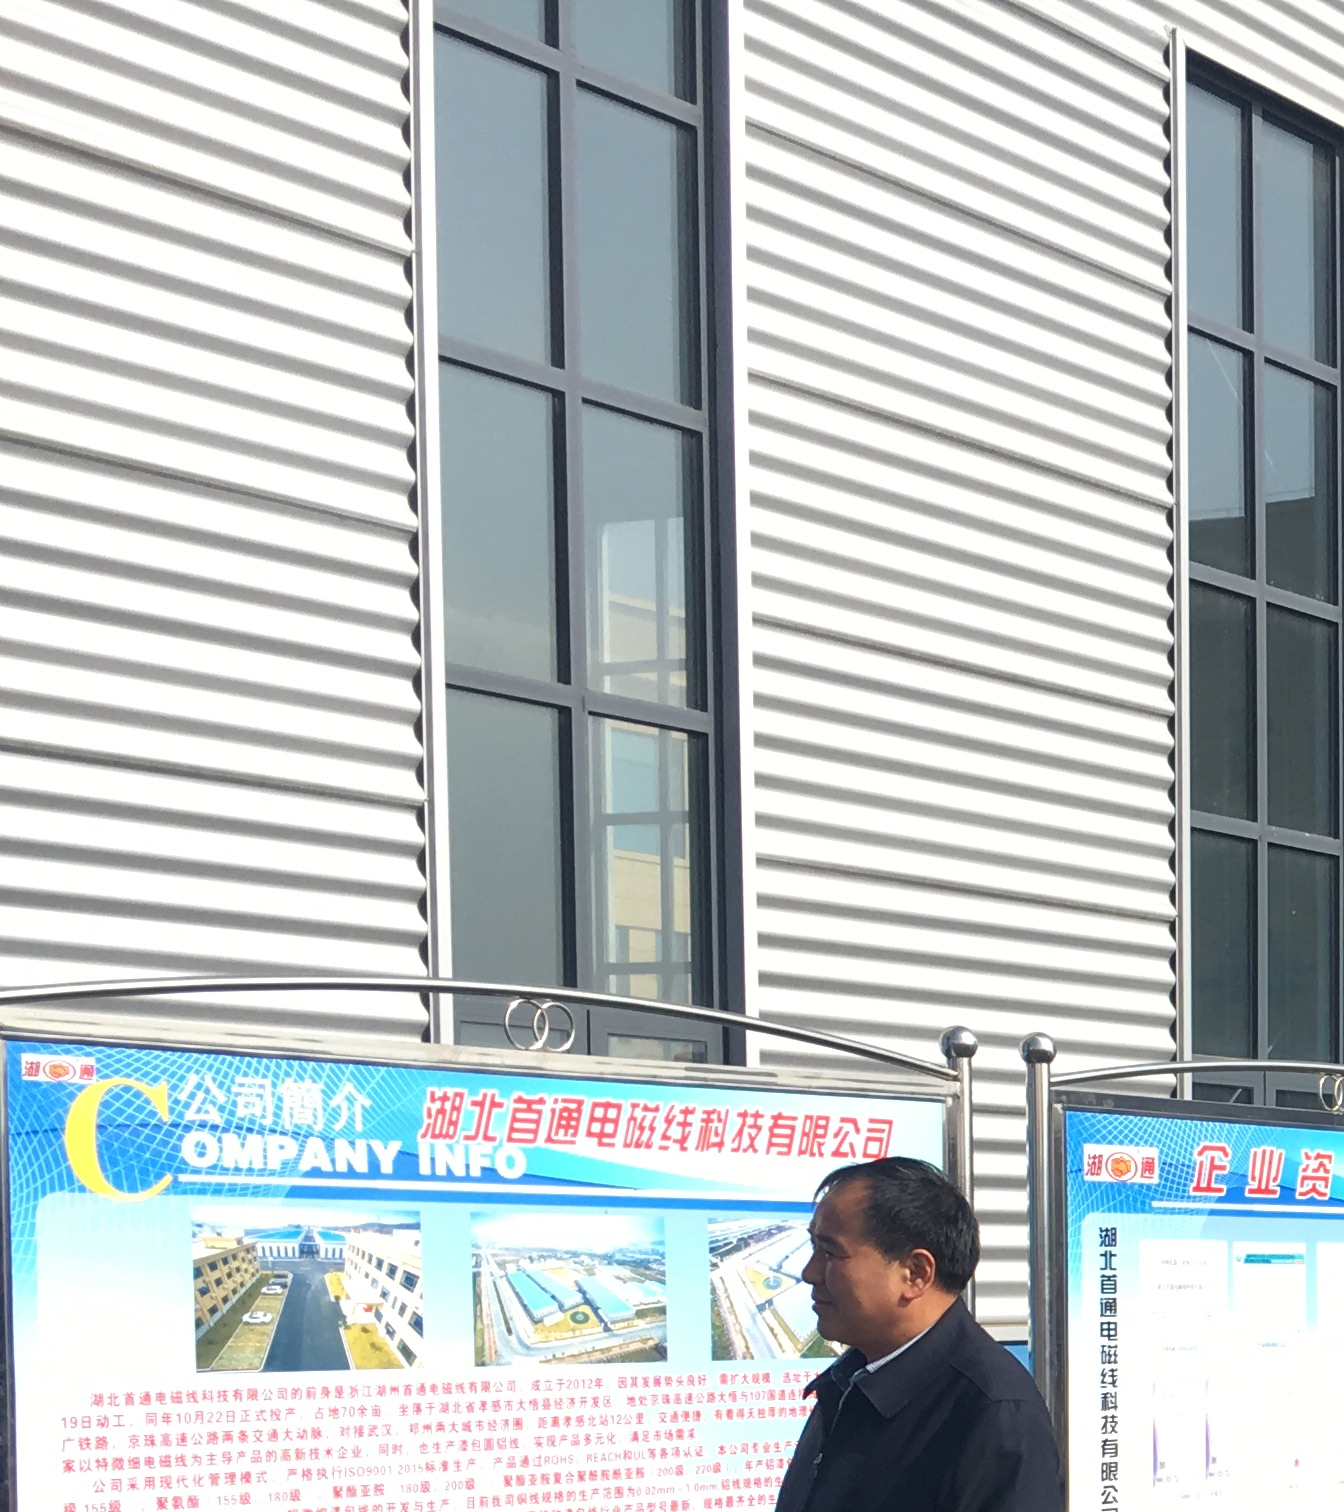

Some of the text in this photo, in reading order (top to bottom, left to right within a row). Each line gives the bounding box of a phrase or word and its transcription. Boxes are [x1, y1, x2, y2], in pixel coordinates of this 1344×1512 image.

[419, 1087, 895, 1161] 湖北首通电磁线科技有限公司
[418, 1142, 528, 1180] INFO
